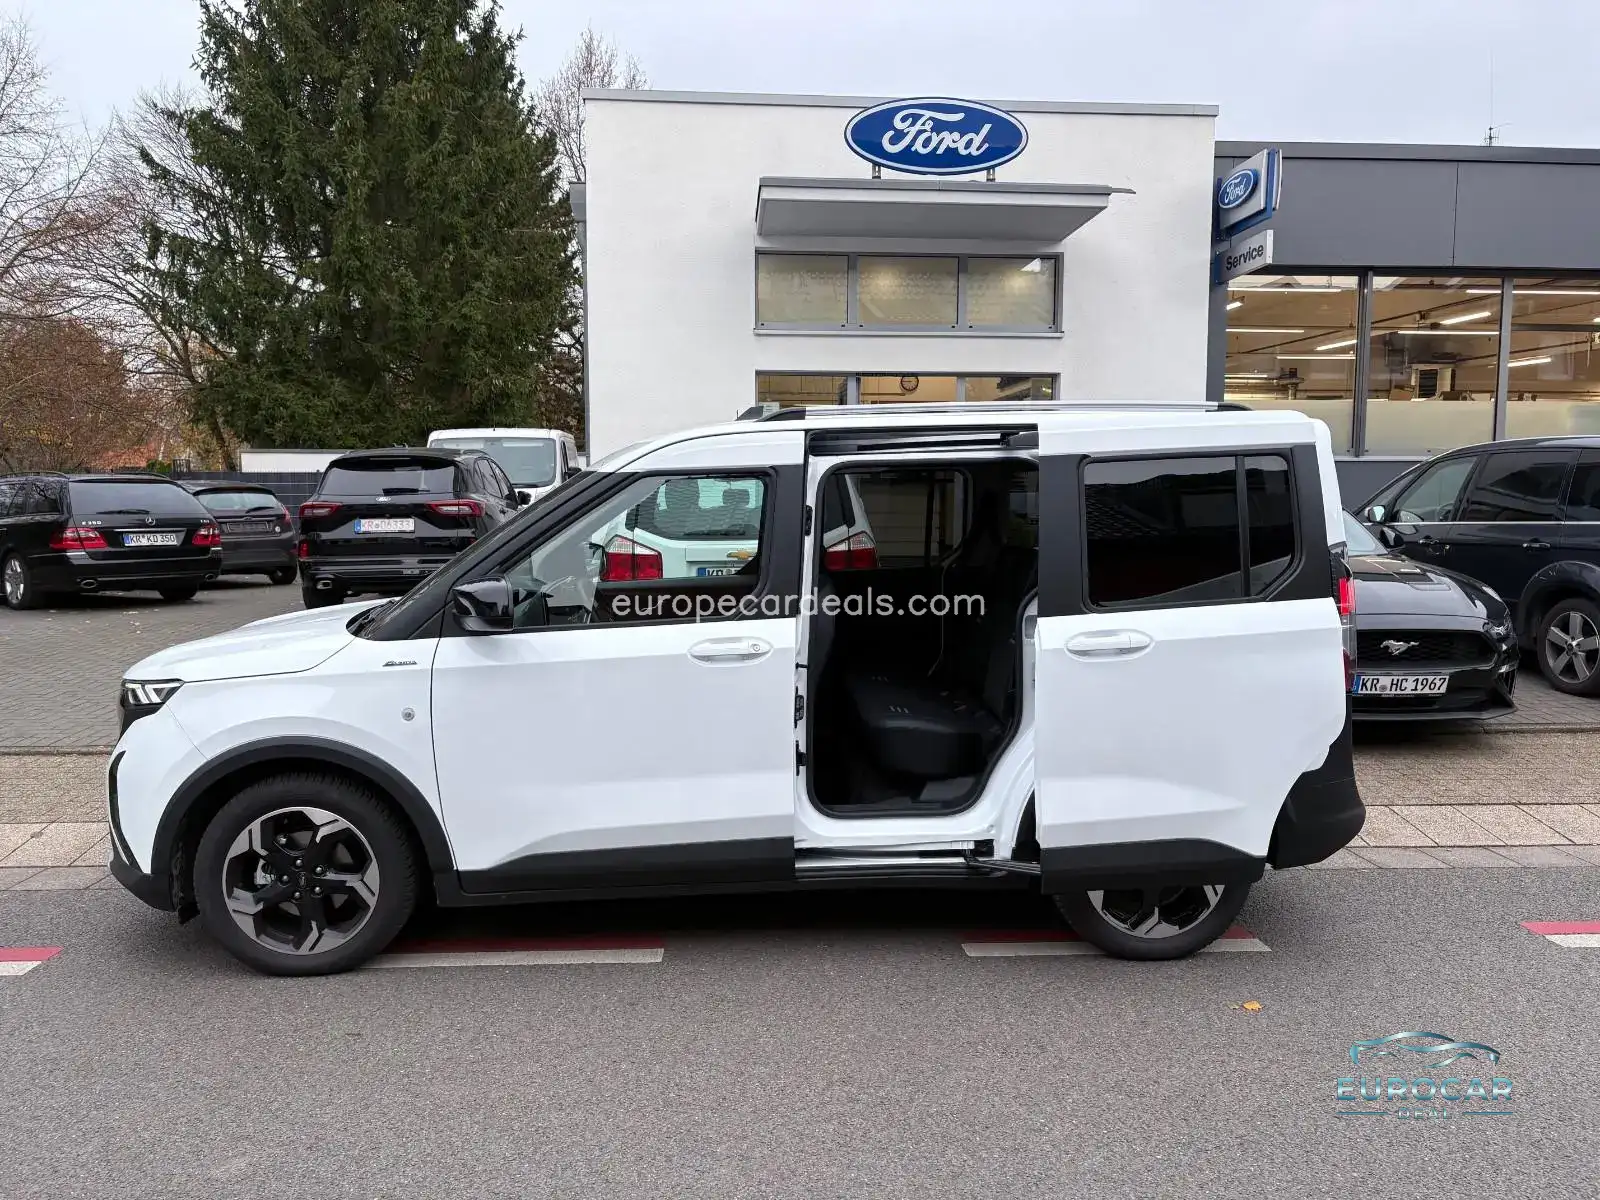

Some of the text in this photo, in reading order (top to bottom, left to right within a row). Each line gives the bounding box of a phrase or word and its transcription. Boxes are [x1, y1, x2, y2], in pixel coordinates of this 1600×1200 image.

[882, 108, 992, 157] Ford
[1224, 177, 1247, 203] Ford
[1226, 244, 1264, 271] Service
[129, 534, 176, 544] KR KD 350
[1360, 677, 1447, 692] KR HC 1967
